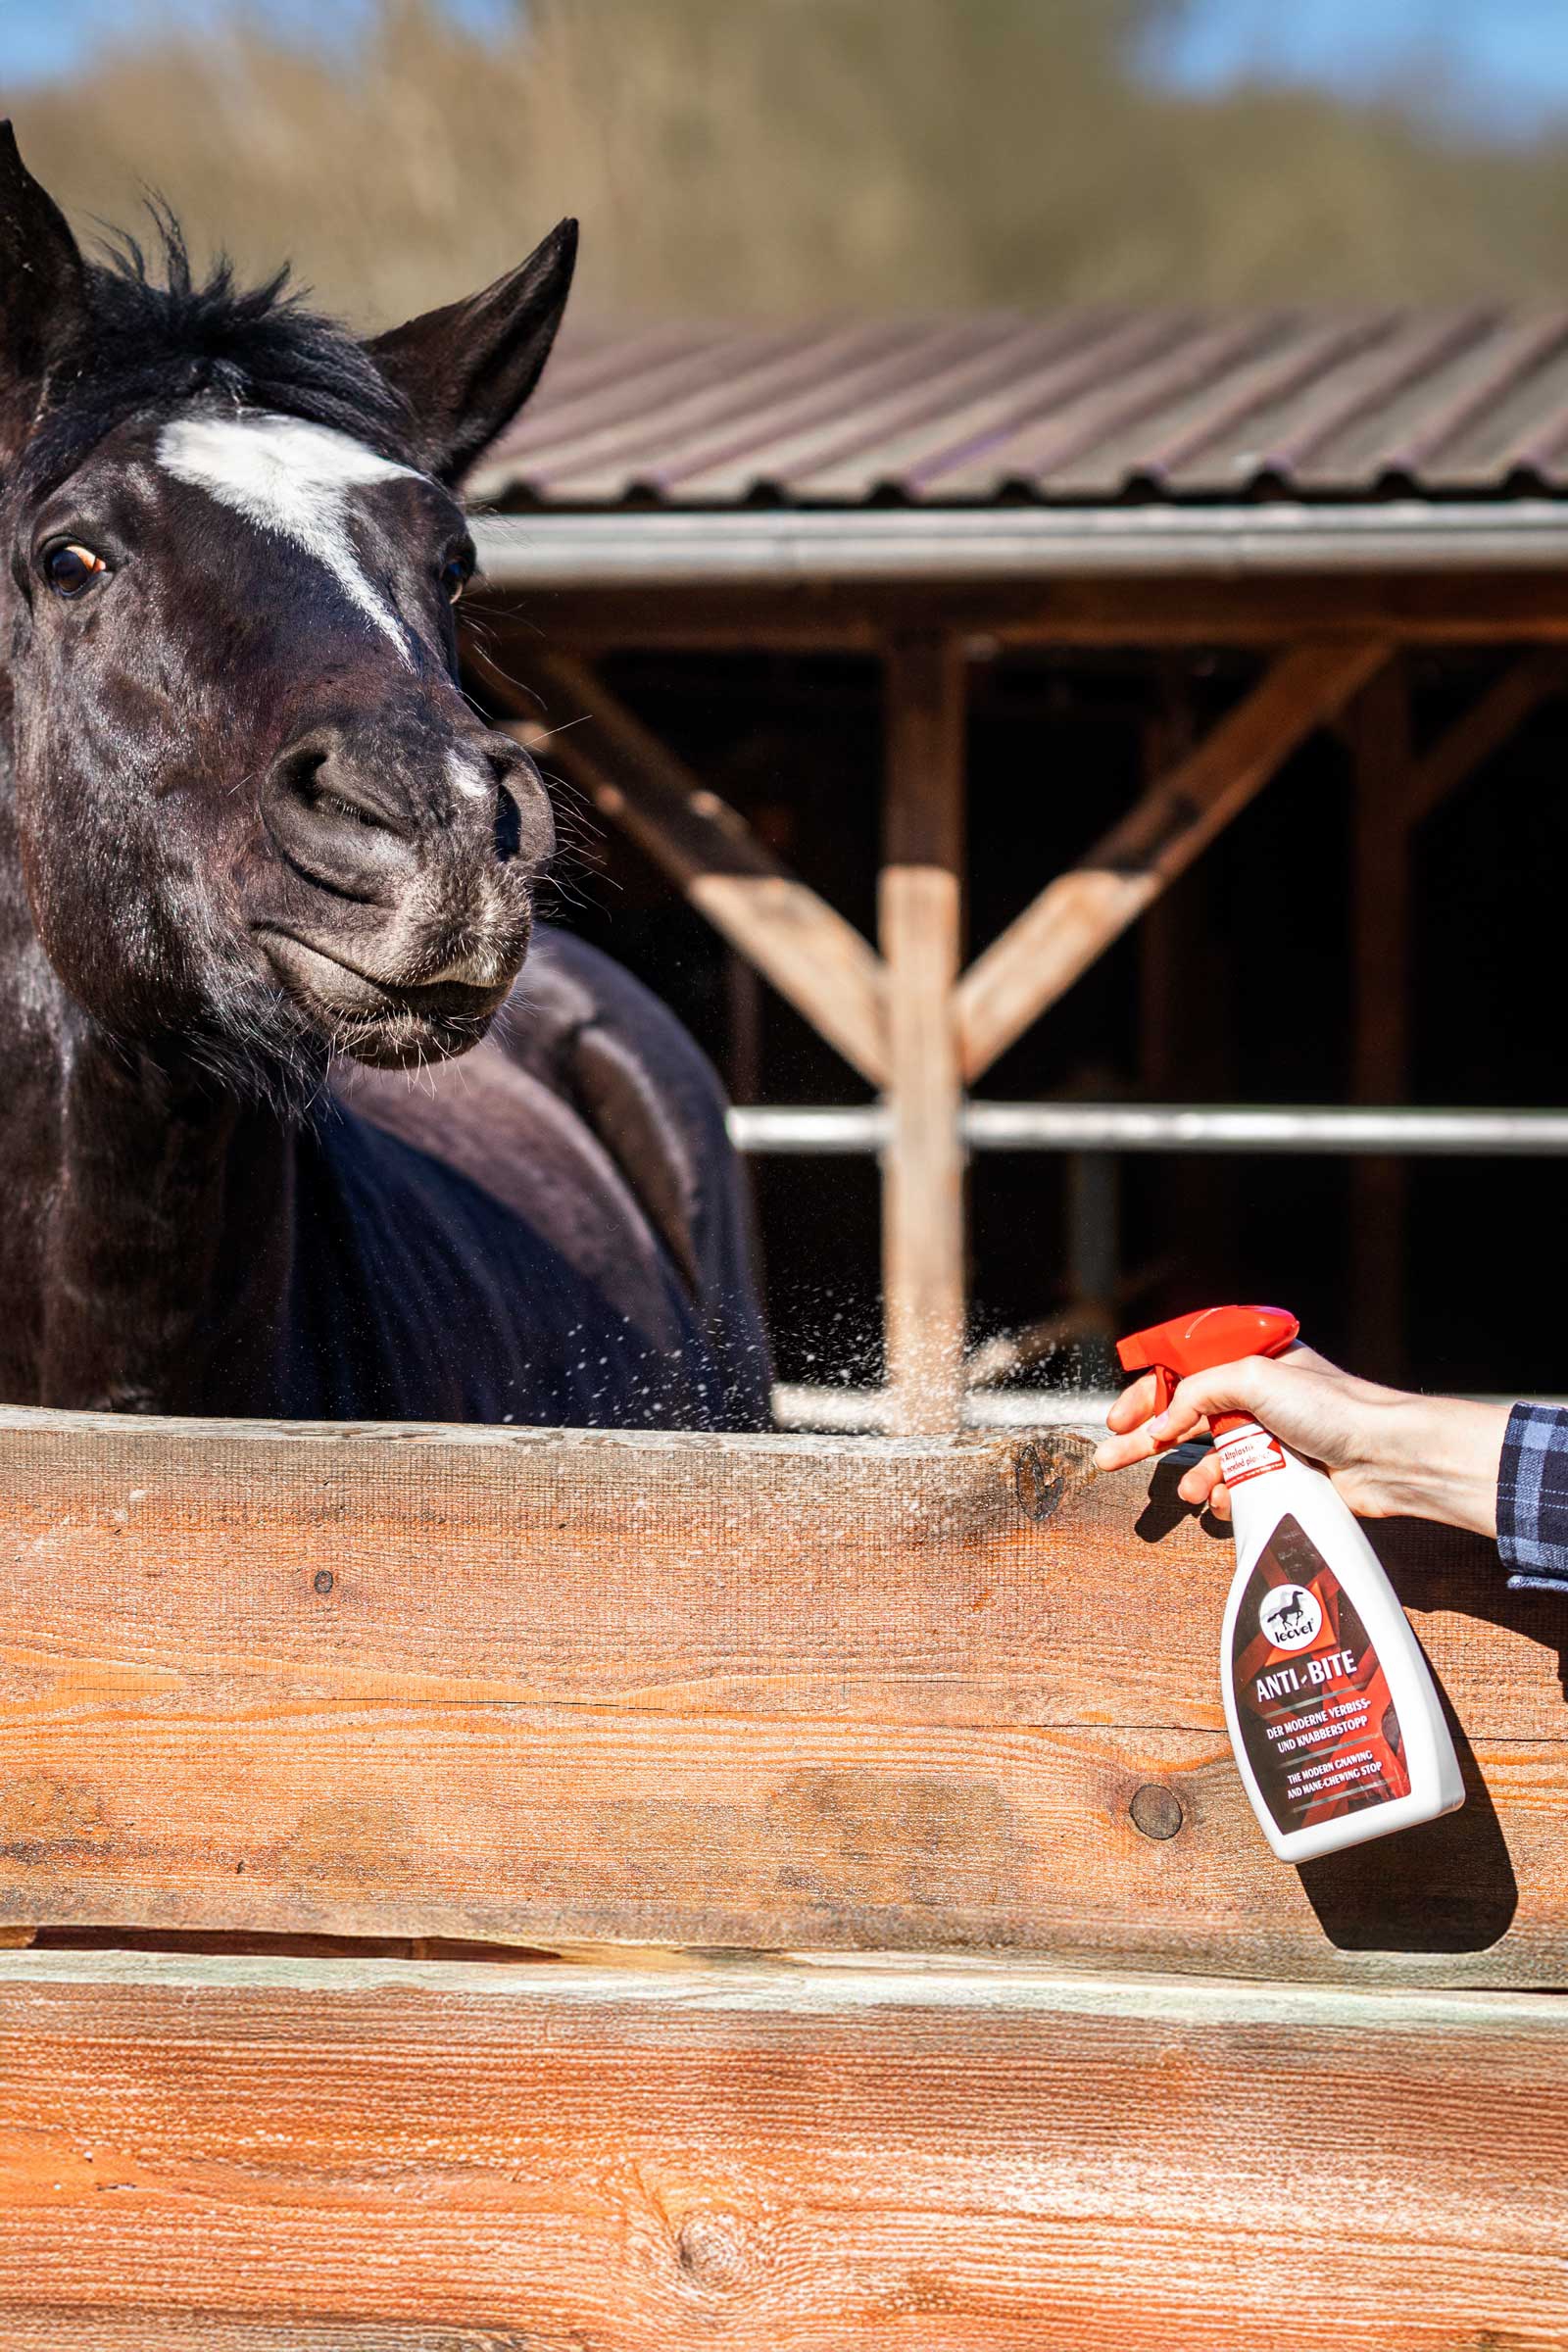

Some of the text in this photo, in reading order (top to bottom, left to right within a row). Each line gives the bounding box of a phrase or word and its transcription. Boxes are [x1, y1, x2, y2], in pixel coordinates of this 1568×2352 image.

[1266, 1697, 1372, 1740] DER MODERNE VERBISS-
[1277, 1715, 1368, 1753] UND KNABBERSTOPP
[1287, 1749, 1373, 1785] THE MODERN GNAWING
[1287, 1761, 1383, 1799] AND MANE-CHEWING STOP
